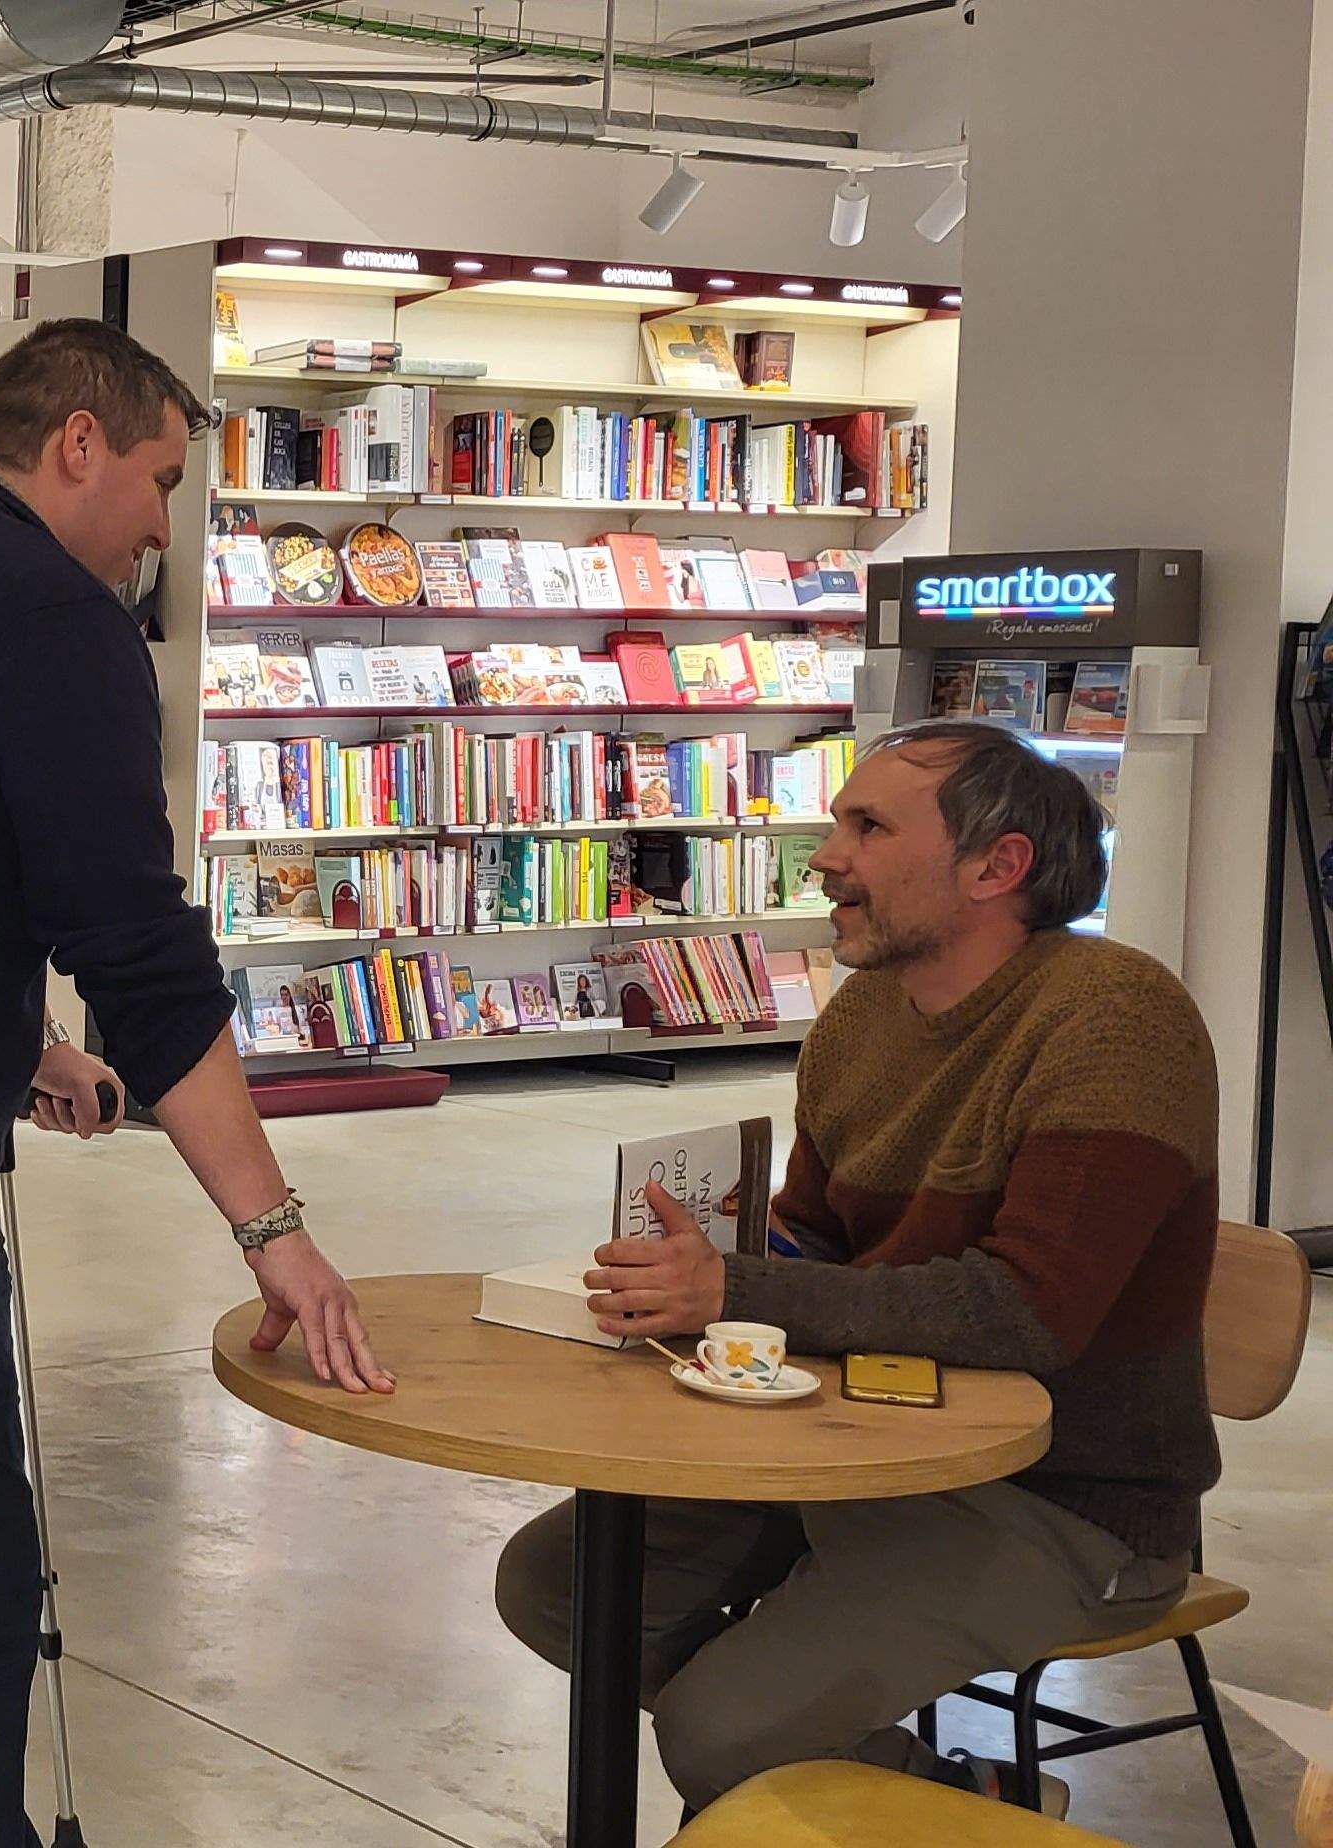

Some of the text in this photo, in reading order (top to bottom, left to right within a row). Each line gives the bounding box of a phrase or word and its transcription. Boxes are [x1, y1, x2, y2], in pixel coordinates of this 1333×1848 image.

[343, 251, 420, 271] GASTRONOMÍA
[602, 267, 674, 288] GASTRONOMÍA
[841, 284, 910, 304] GASTRONOMÍA
[359, 547, 406, 567] Paellas
[916, 567, 1117, 606] smartbox
[986, 618, 1100, 640] ¡Regala emociones!
[259, 842, 303, 857] Masas
[629, 1186, 646, 1240] UIS
